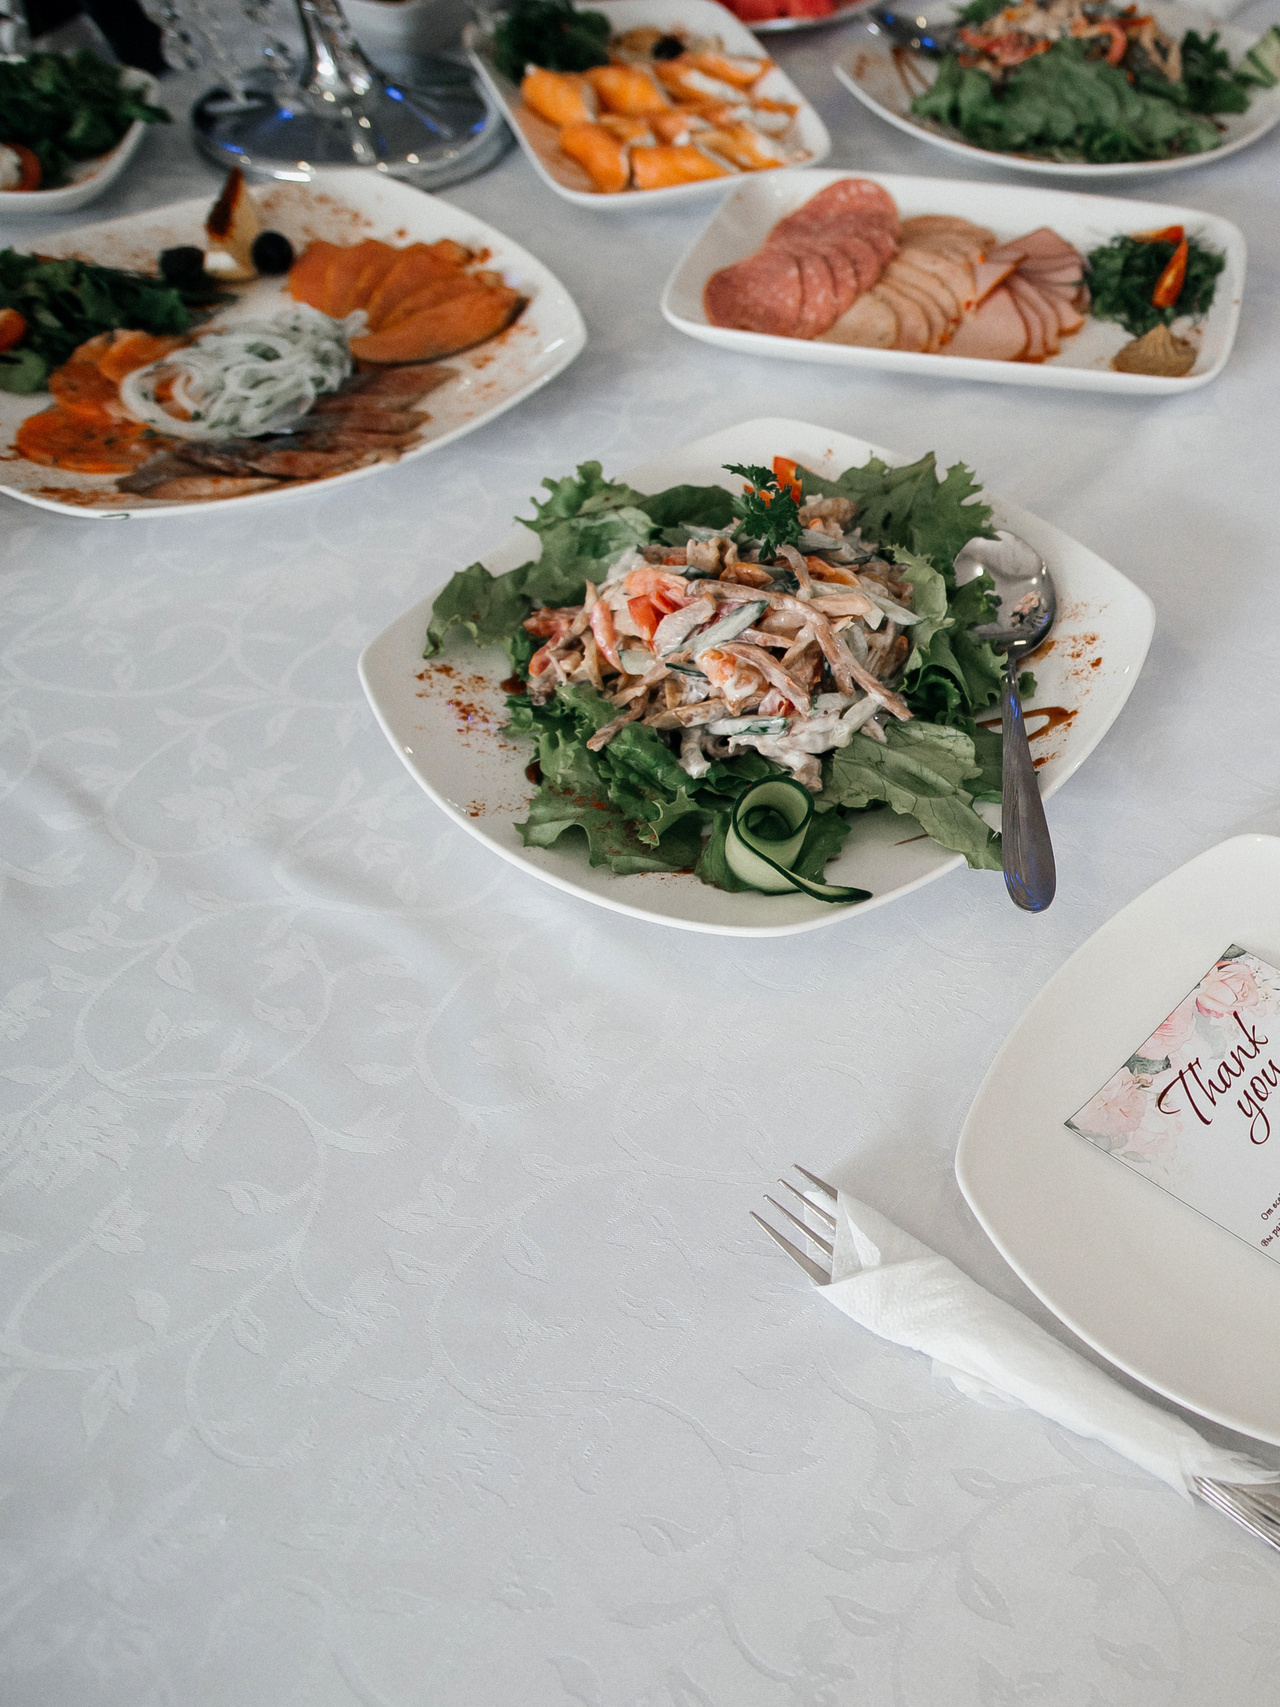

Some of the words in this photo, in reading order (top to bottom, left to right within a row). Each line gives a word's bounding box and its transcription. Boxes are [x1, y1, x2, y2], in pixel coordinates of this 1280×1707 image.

[1157, 1011, 1269, 1125] Thank
[1261, 1208, 1274, 1220] От
[1261, 1235, 1273, 1247] Вы
